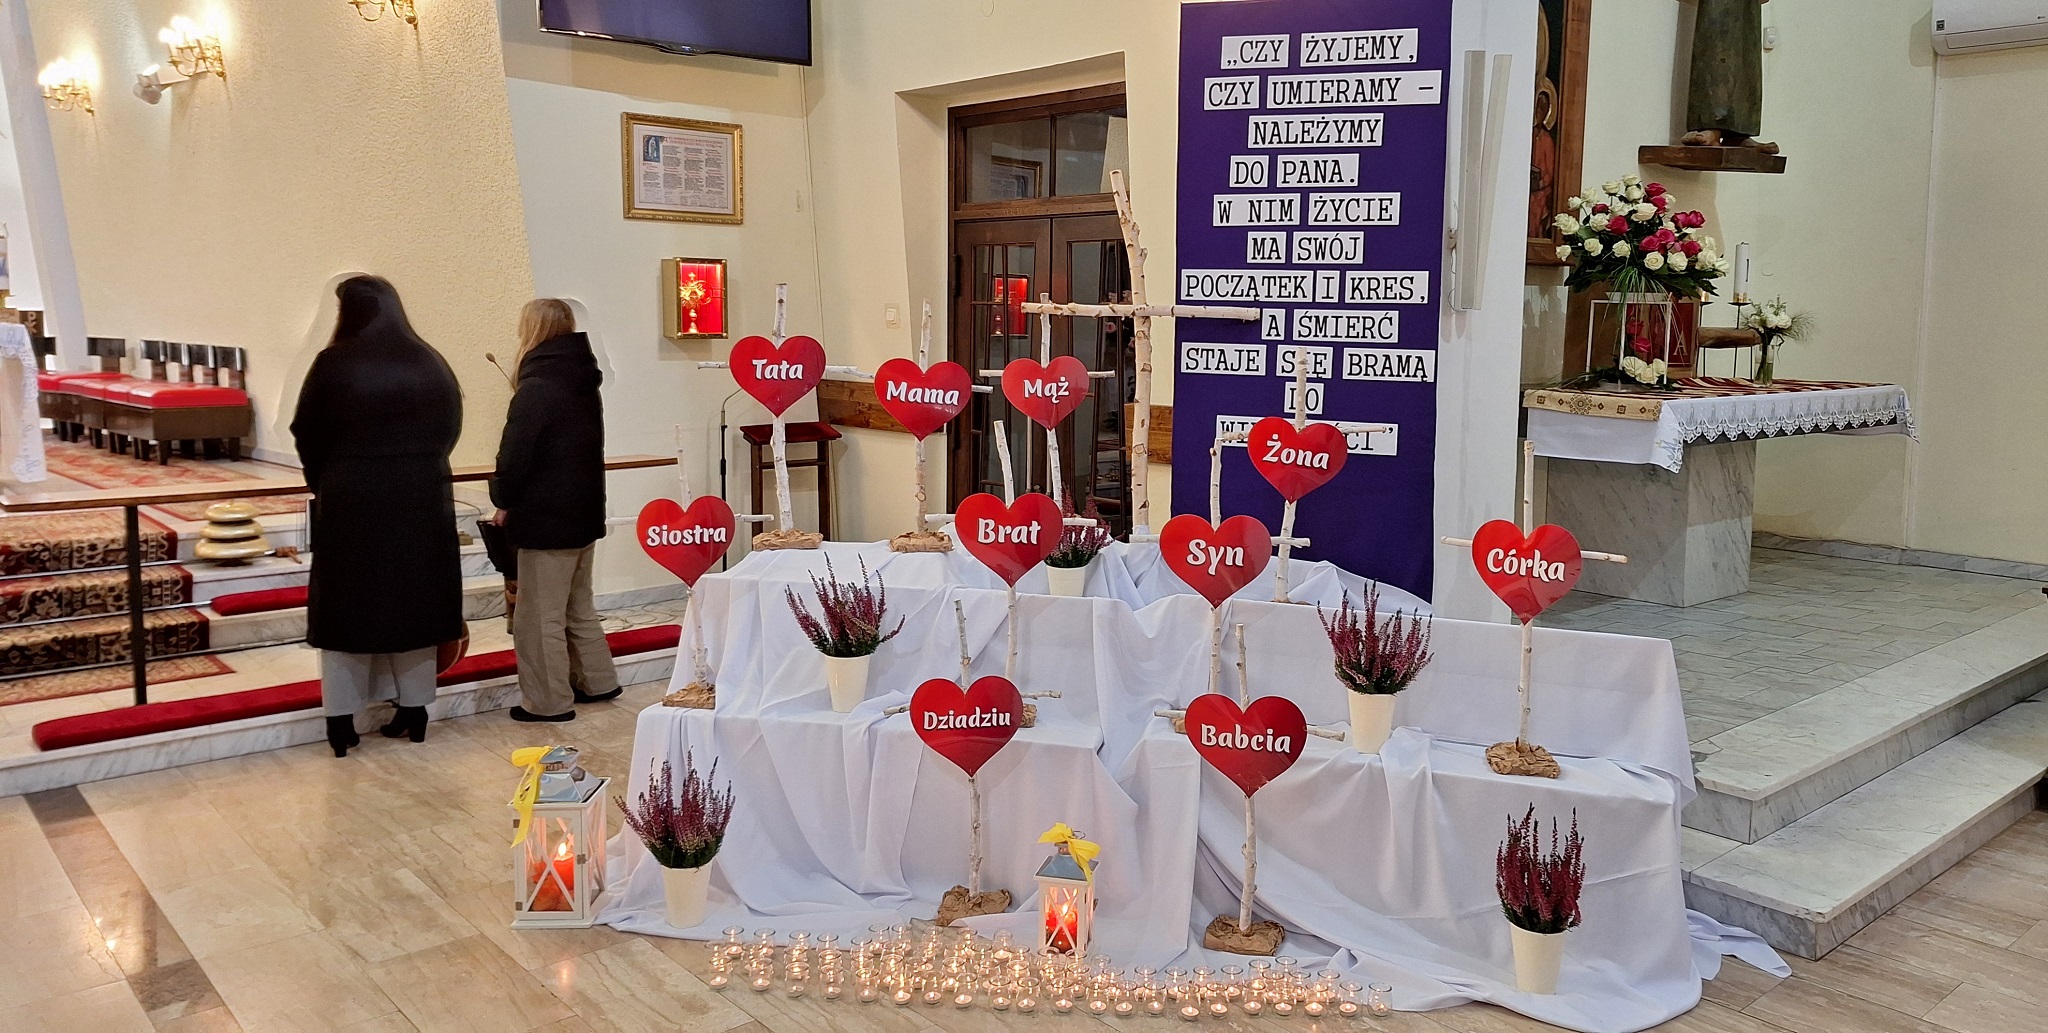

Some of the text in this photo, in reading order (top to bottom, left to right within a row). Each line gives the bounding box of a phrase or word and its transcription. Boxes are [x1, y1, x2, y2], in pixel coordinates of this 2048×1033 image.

[1226, 35, 1414, 66] „CZY ŻYJEMY,
[1208, 81, 1255, 106] CZY
[1272, 77, 1401, 105] UMIERAMY
[1253, 116, 1381, 146] NALEŻYMY
[1234, 159, 1355, 185] DO PANA.
[1217, 195, 1393, 224] W NIM ŻYCIE
[1251, 232, 1360, 261] MA SWÓJ
[1185, 274, 1426, 303] POCZĄTEK I KRES,
[1266, 310, 1394, 340] A ŚMIERĆ
[752, 358, 803, 380] Tata
[1185, 347, 1428, 382] STAJE SĘ BRAMĄ
[886, 380, 960, 406] Mama
[1023, 376, 1069, 404] Mąż
[1262, 433, 1330, 471] Żona
[646, 524, 727, 547] Siostra
[977, 518, 1042, 545] Brat
[1186, 538, 1245, 576] Syn
[1486, 548, 1566, 582] Córka
[923, 706, 1012, 731] Dziadziu
[1200, 723, 1292, 754] Babcia
